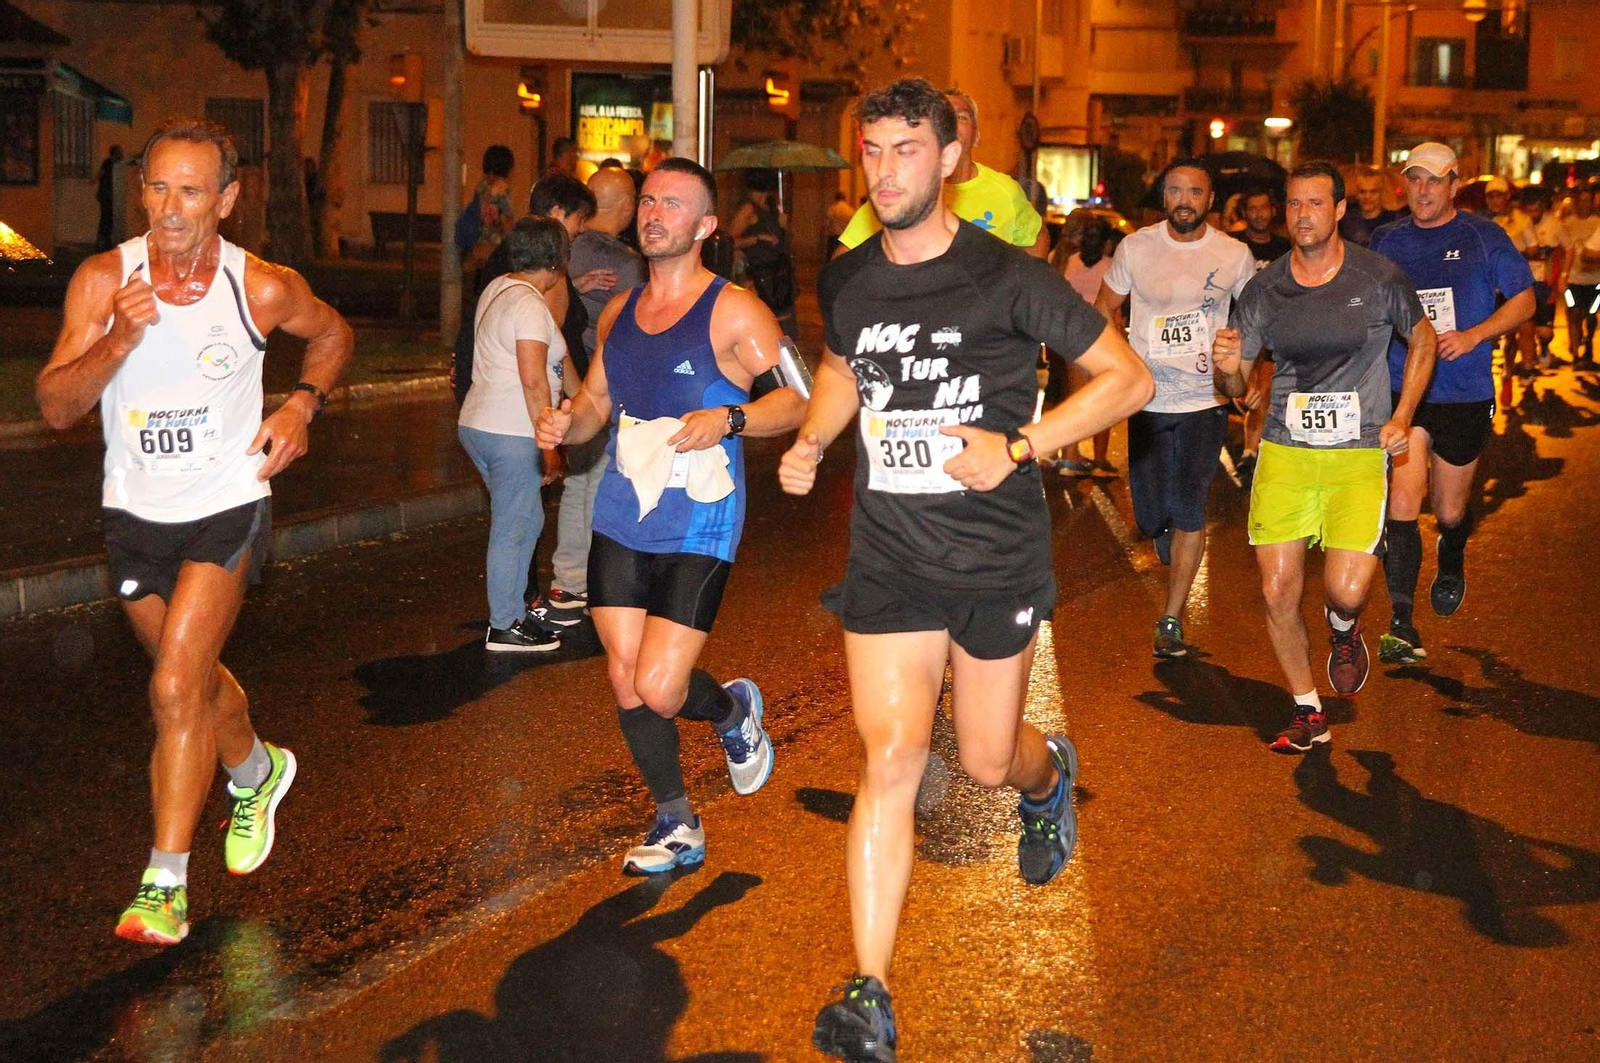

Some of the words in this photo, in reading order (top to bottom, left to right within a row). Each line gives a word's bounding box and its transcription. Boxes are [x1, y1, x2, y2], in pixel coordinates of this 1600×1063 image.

[1166, 312, 1199, 322] NOCTURNA
[856, 322, 921, 355] NOC
[1161, 326, 1191, 344] 443
[900, 355, 949, 382] TUR
[933, 373, 980, 408] NA
[146, 419, 162, 428] DE
[165, 415, 208, 428] HUELVA
[148, 406, 209, 419] NOCTURNA
[886, 416, 945, 428] NOCTURNA
[1301, 409, 1338, 429] 551
[140, 428, 194, 454] 609
[886, 428, 898, 438] DE
[880, 440, 932, 467] 320
